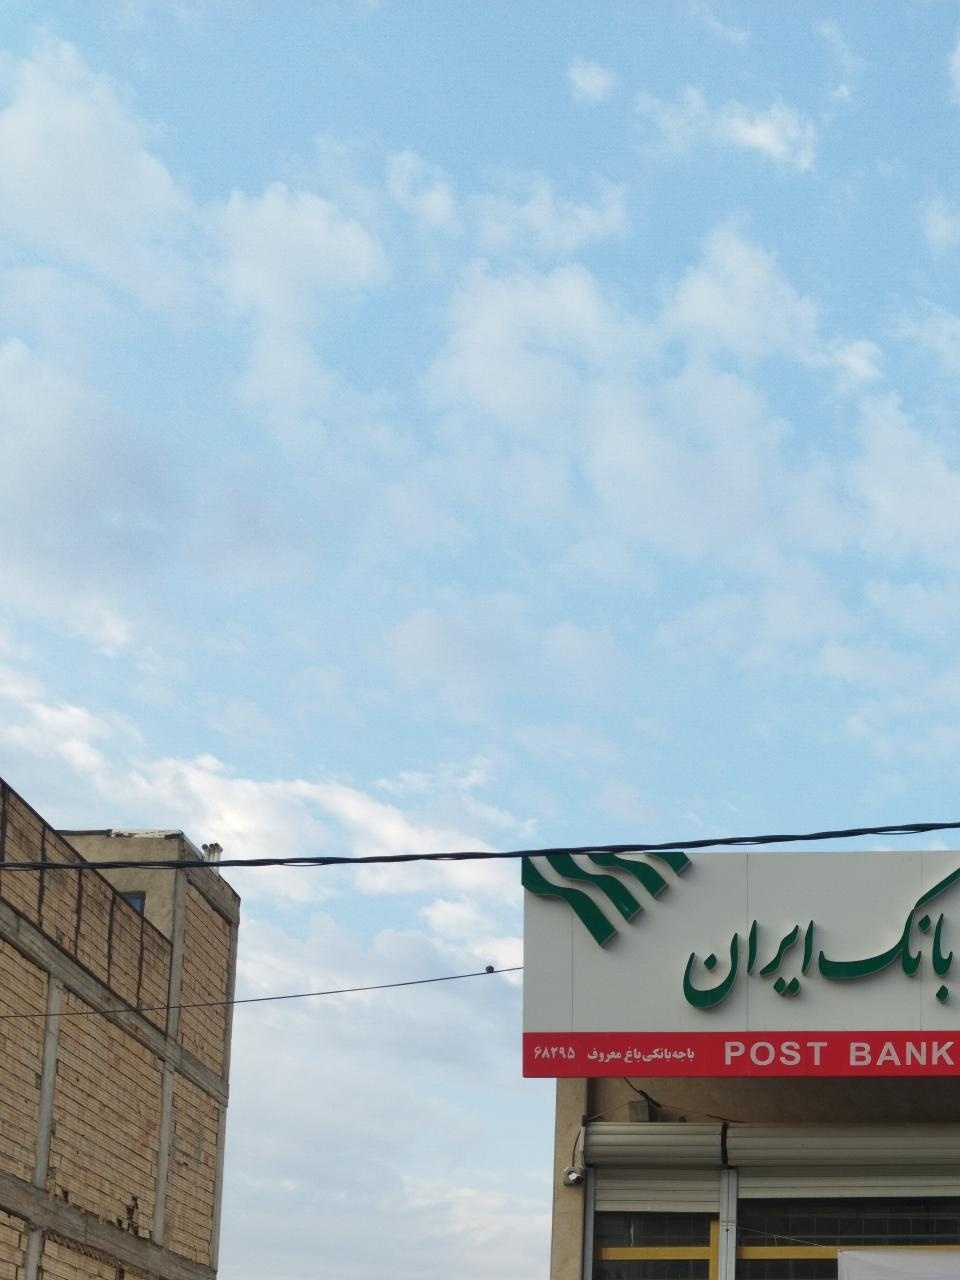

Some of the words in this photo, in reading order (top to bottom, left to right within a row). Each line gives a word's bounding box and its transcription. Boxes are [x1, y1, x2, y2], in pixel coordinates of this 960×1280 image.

[683, 919, 816, 1009] ایران
[586, 1047, 622, 1064] معروف
[724, 1041, 828, 1066] POST
[849, 1041, 956, 1066] BANK
